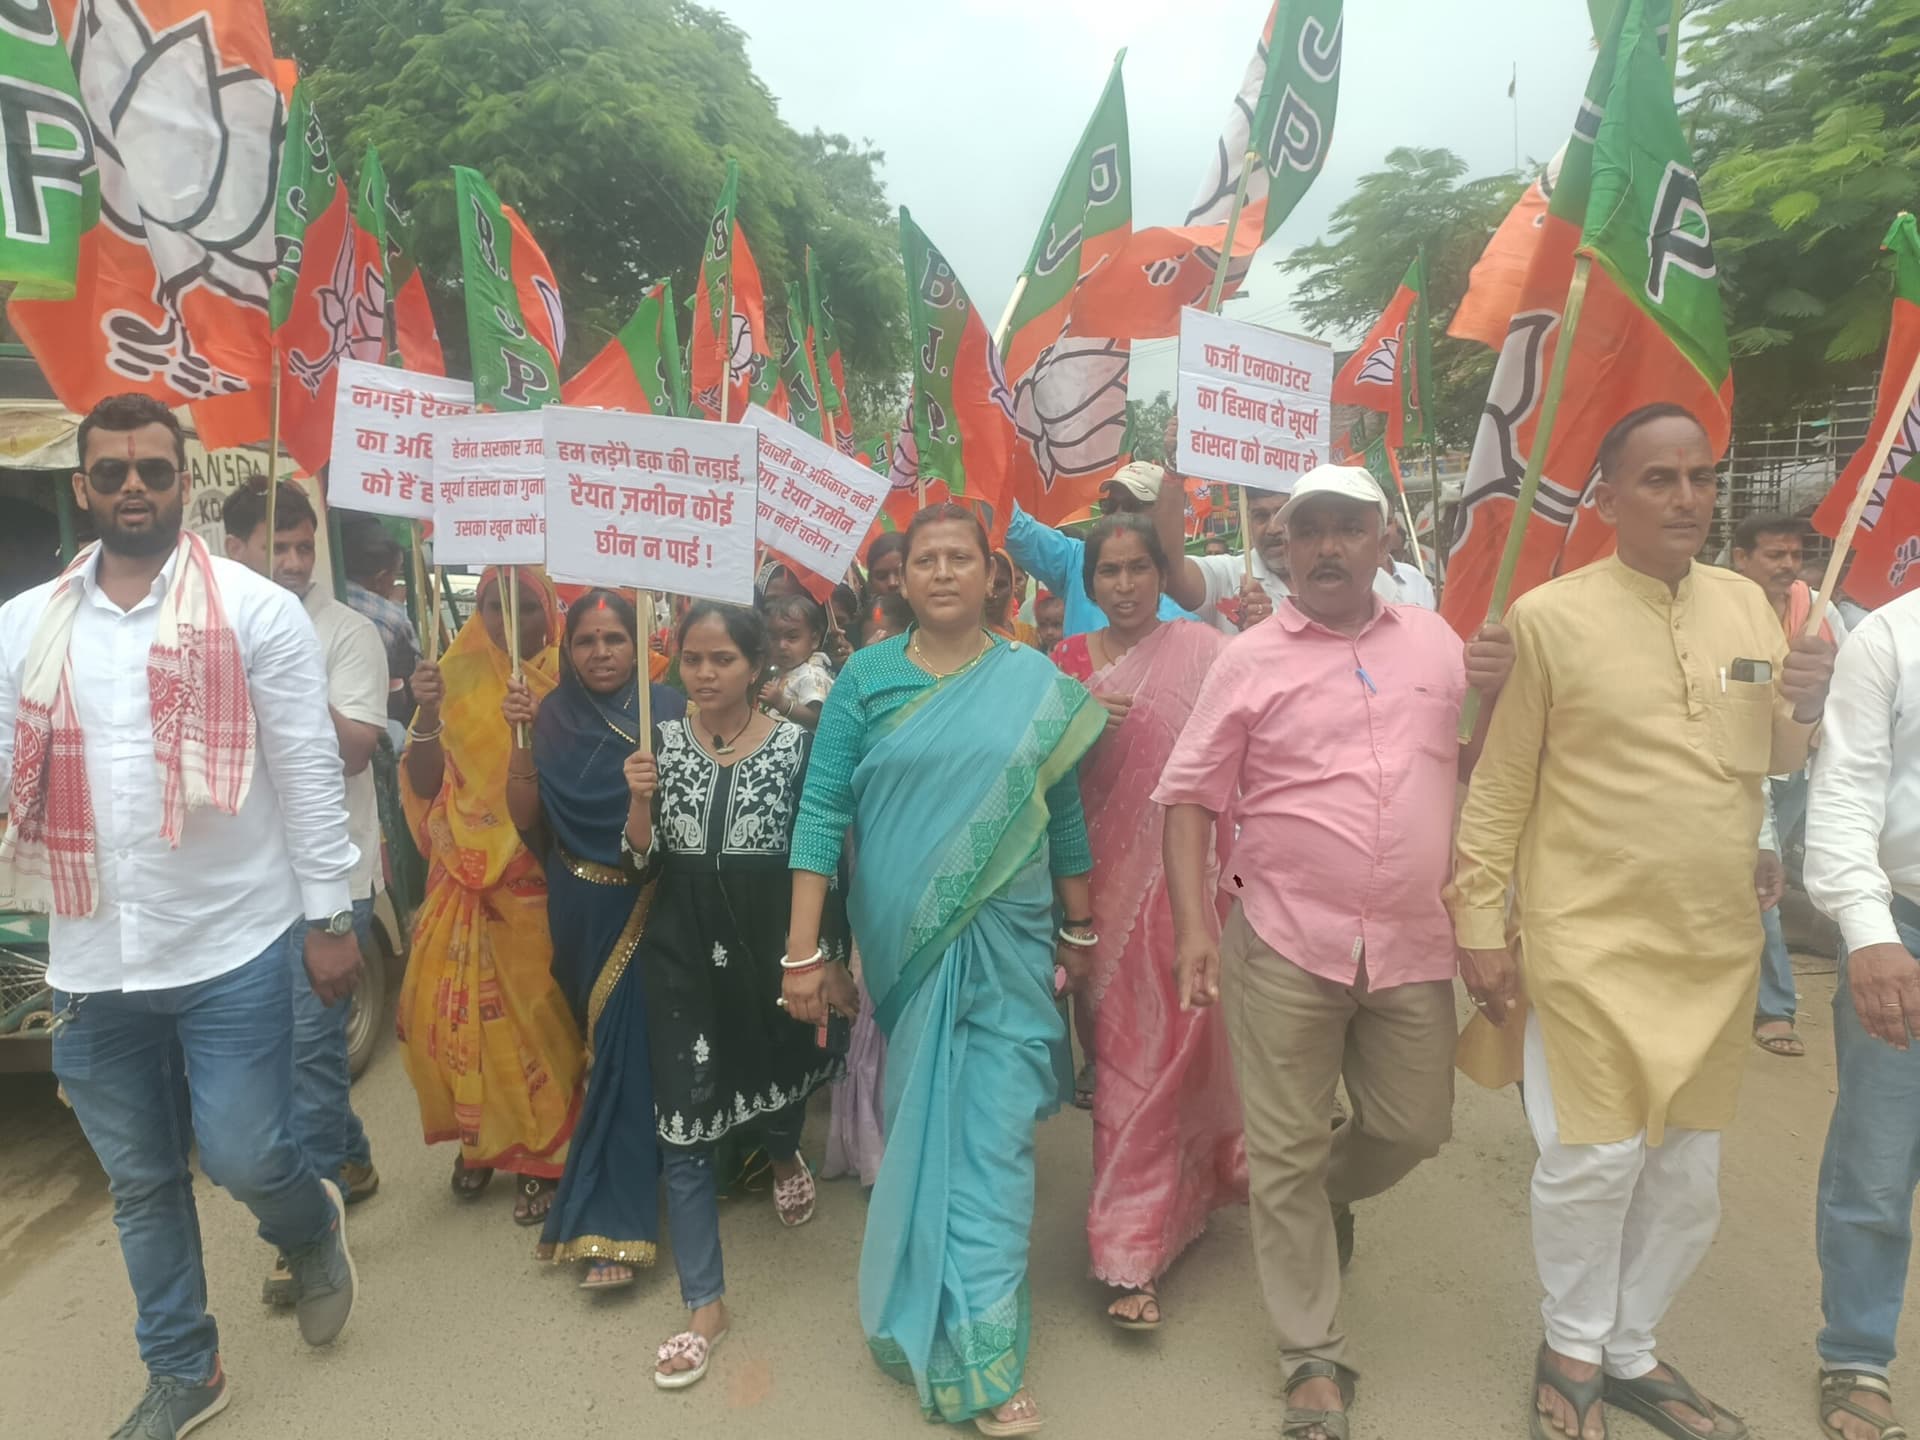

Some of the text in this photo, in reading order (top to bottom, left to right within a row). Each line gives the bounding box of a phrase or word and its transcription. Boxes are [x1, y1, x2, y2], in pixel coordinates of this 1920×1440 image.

[1242, 353, 1312, 392] एनकाउंटर
[1197, 386, 1219, 412] का
[1221, 387, 1268, 424] हिसाब
[1270, 398, 1286, 427] दो
[355, 428, 389, 453] का
[451, 437, 479, 459] हेमंत
[480, 440, 521, 457] सरकार
[1190, 426, 1238, 460] हांसदा
[1240, 437, 1261, 464] को
[1263, 445, 1300, 472] न्याय
[556, 441, 586, 463] हम
[666, 447, 690, 475] की
[361, 467, 394, 497] को
[398, 470, 419, 500] हैं
[440, 476, 465, 504] सूर्या
[467, 476, 501, 497] हांसदा
[503, 480, 519, 496] का
[781, 476, 815, 511] रैयत
[791, 456, 809, 474] का
[807, 466, 852, 500] अधिकार
[568, 473, 617, 510] रैयत
[691, 488, 735, 527] कोई
[454, 520, 487, 537] उसका
[489, 520, 513, 542] खून
[515, 513, 537, 536] क्यों
[594, 524, 638, 558] छीन
[641, 536, 663, 561] न
[799, 525, 833, 554] चलेगा
